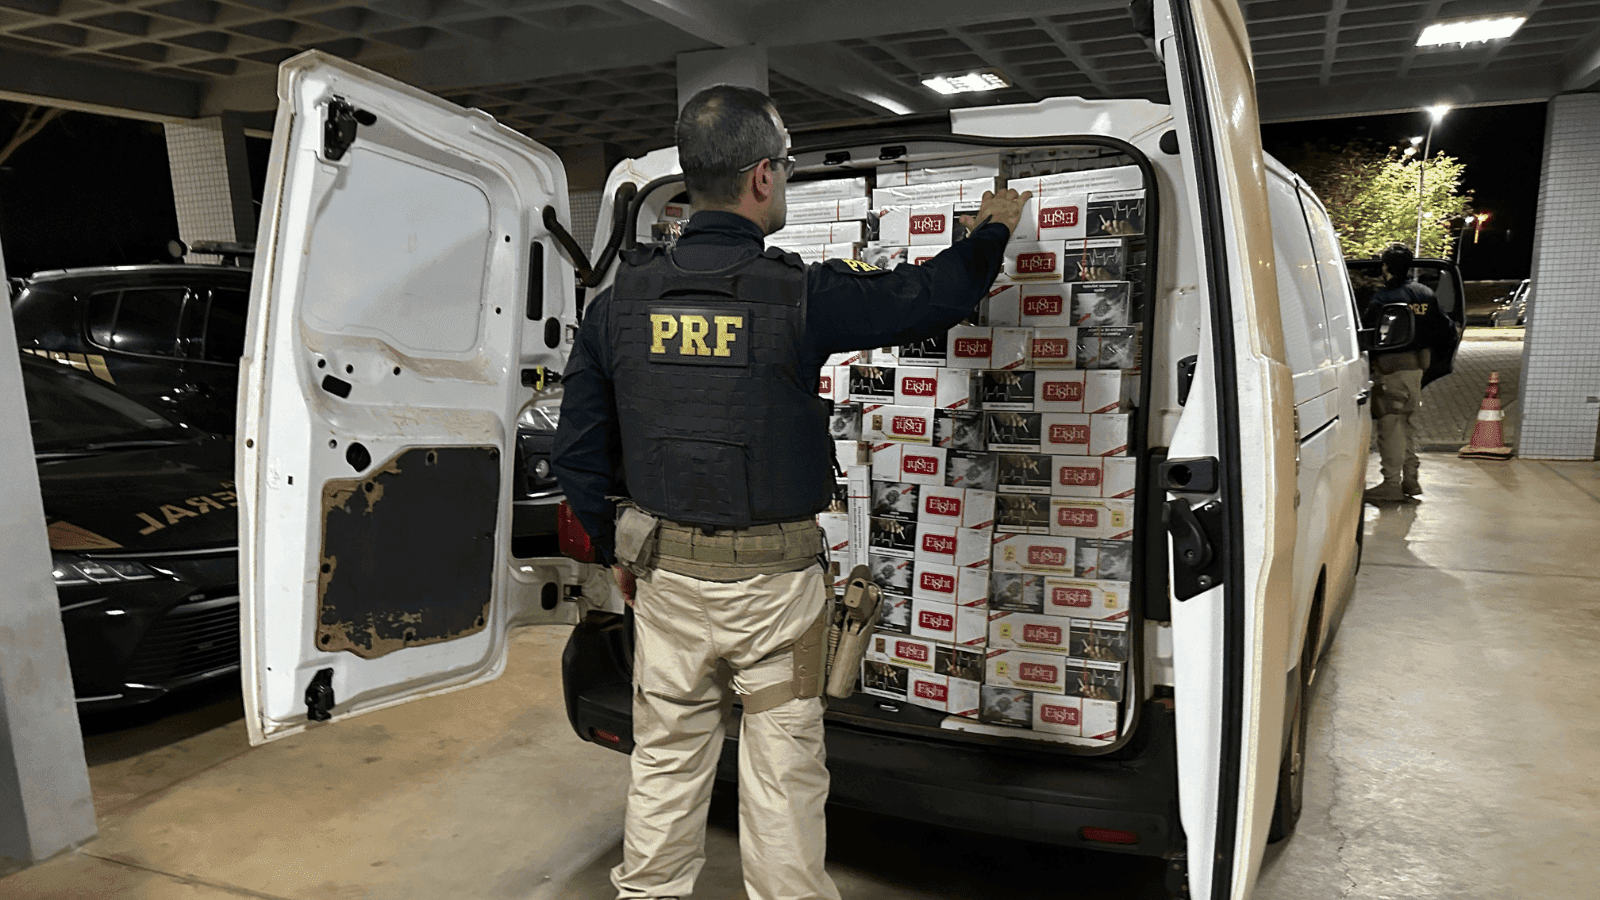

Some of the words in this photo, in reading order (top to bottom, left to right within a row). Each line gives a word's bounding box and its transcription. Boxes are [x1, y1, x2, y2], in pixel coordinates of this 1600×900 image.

[914, 217, 942, 232] Eight
[1043, 209, 1075, 226] Eight
[842, 259, 882, 272] PR
[1020, 255, 1053, 271] Eight
[1028, 298, 1059, 313] Eight
[650, 314, 743, 357] PRF
[959, 340, 987, 355] Eight
[1033, 341, 1064, 356] Eight
[905, 379, 933, 393] Eight
[1047, 385, 1077, 399] Eight
[896, 419, 923, 434] Eight
[1053, 427, 1085, 442] Eight
[907, 457, 934, 474] Eight
[1064, 468, 1096, 484] Eight
[929, 498, 957, 514] Eight
[1061, 509, 1093, 525] Eight
[926, 536, 953, 552] Eight
[1032, 548, 1062, 564] Eight
[924, 574, 951, 590] Eight
[1056, 589, 1089, 605] Eight
[923, 613, 949, 628] Eight
[1028, 626, 1058, 643] Eight
[899, 642, 925, 659] Eight
[1023, 663, 1053, 681] Eight
[918, 682, 944, 698] Eight
[1045, 707, 1076, 722] Eight
